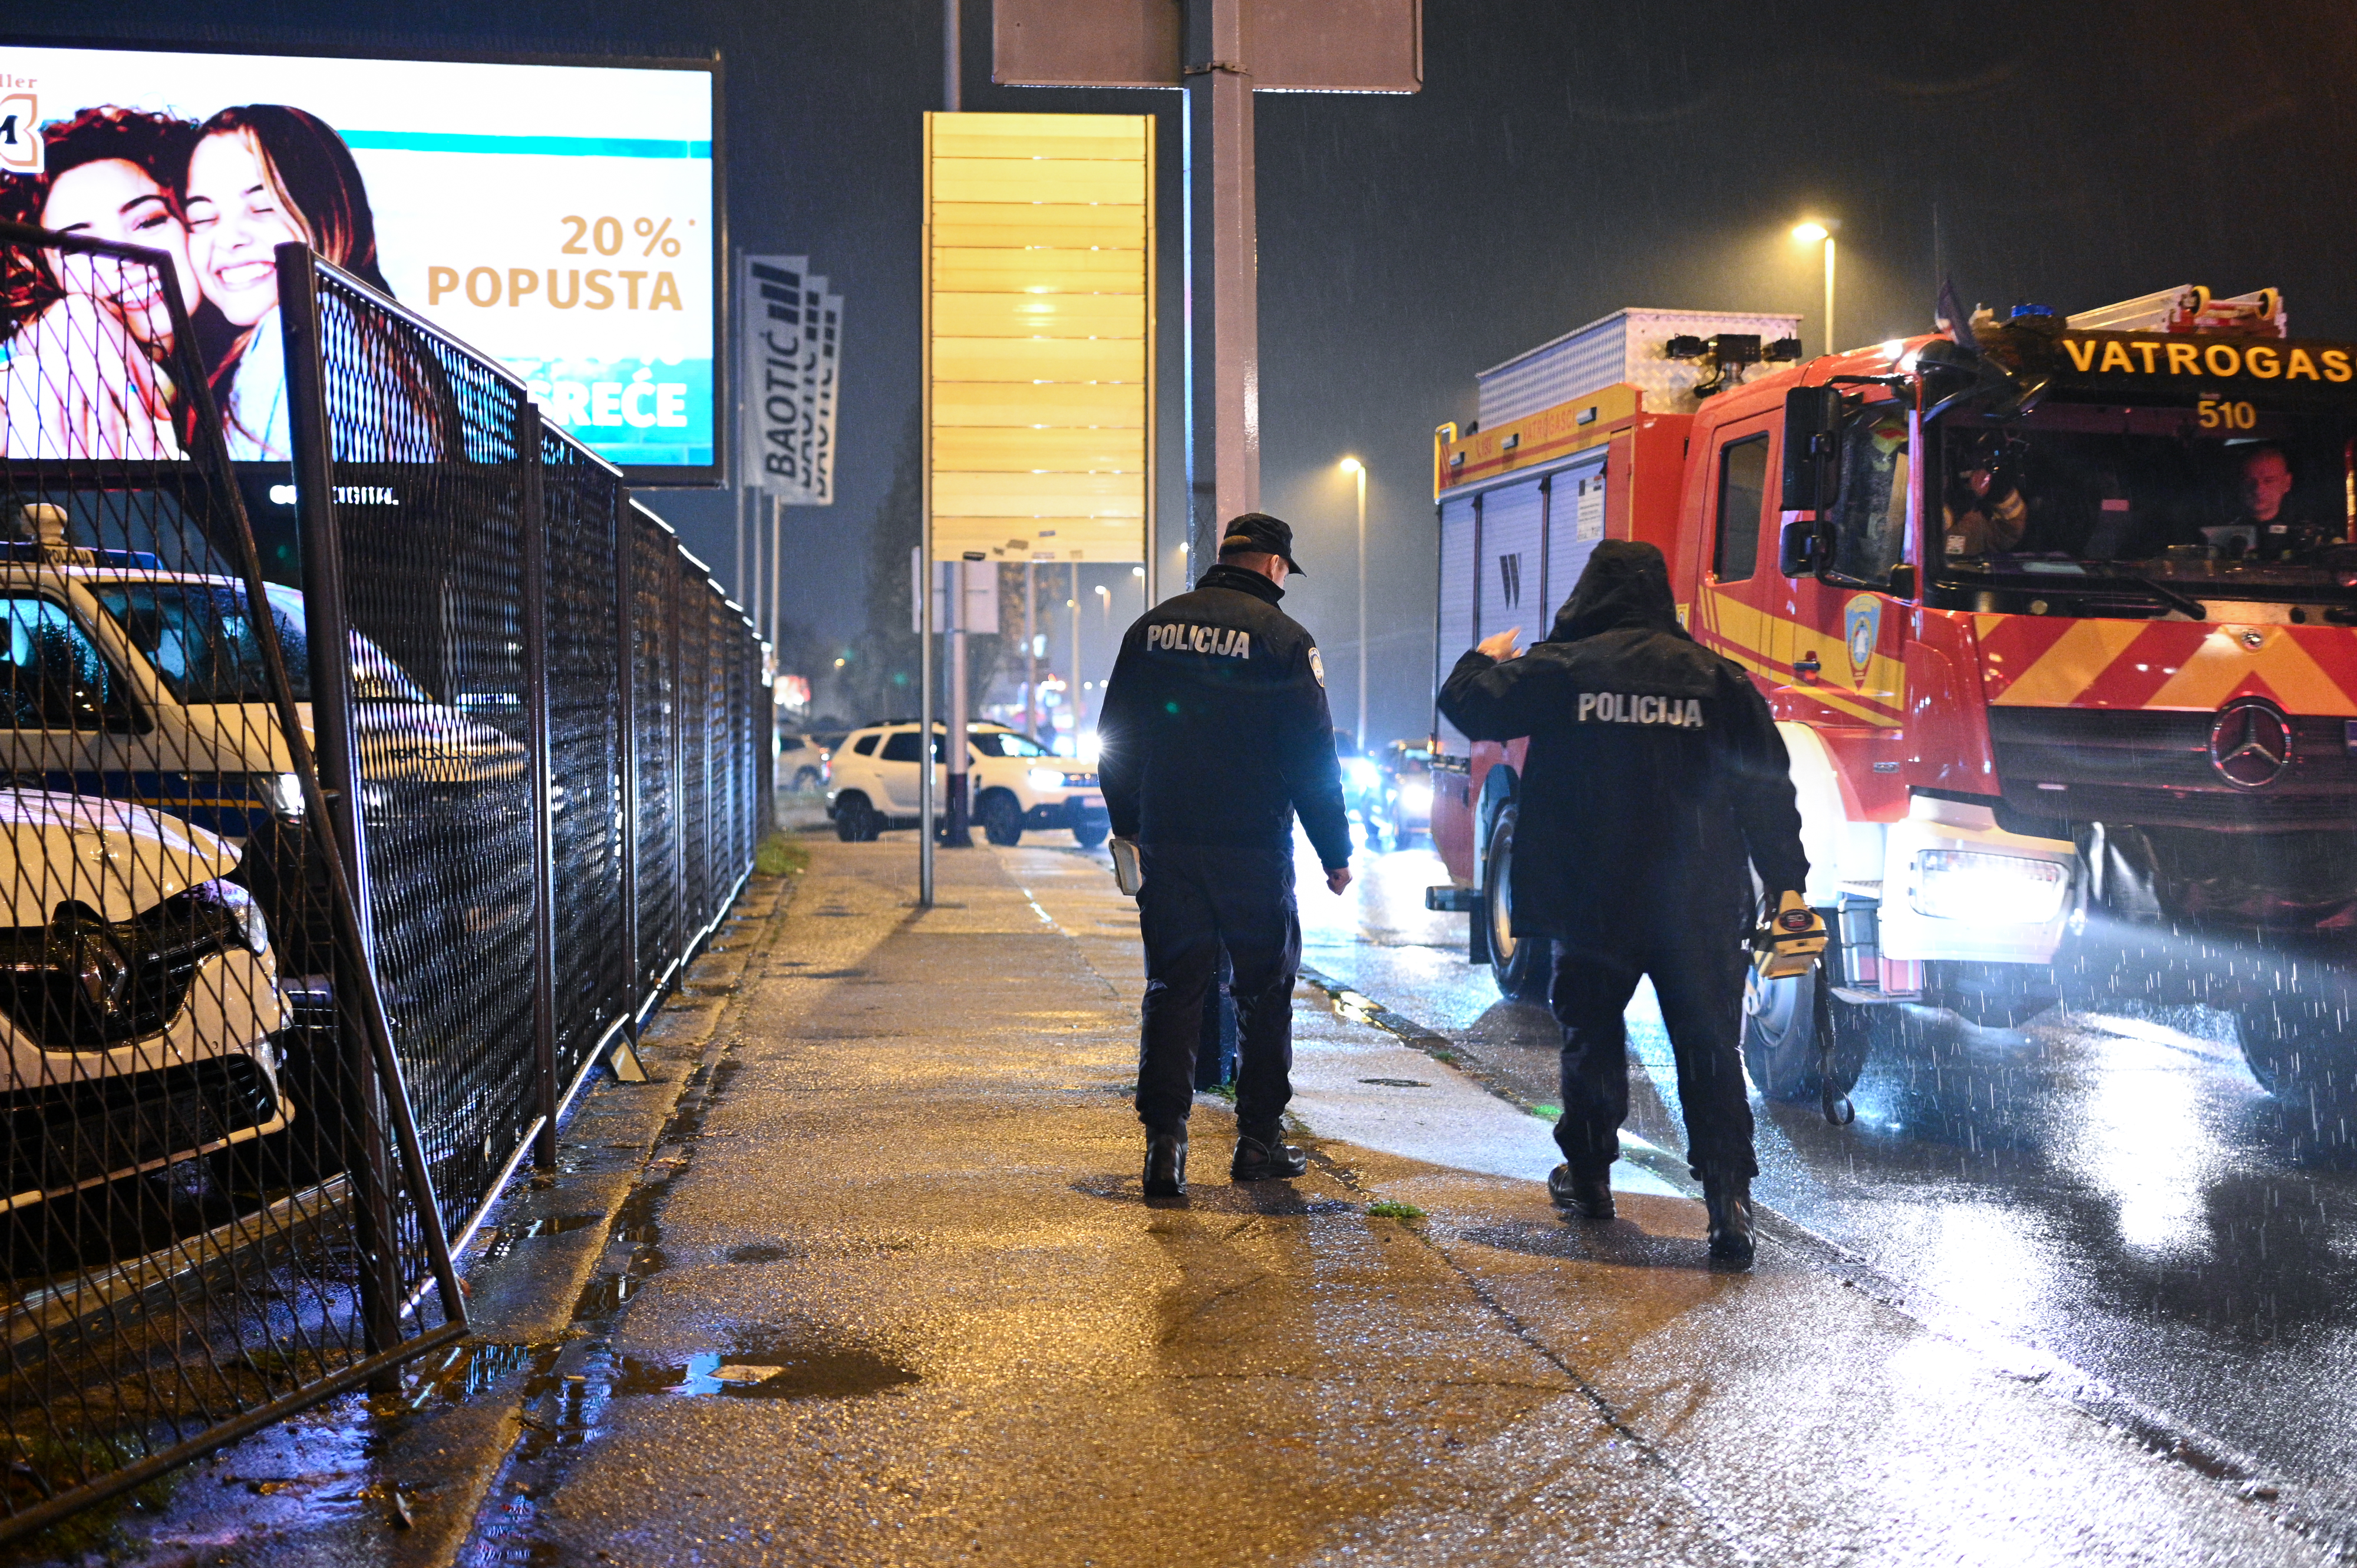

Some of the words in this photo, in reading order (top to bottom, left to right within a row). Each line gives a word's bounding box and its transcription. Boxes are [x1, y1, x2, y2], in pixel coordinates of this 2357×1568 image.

[428, 266, 683, 311] POPUSTA
[2063, 339, 2357, 382] VATROGAS
[526, 367, 687, 428] SREĆE
[760, 331, 798, 478] BAOTIĆ
[2198, 400, 2256, 429] 510
[1147, 624, 1250, 659] POLICIJA
[1578, 692, 1704, 728] POLICIJA
